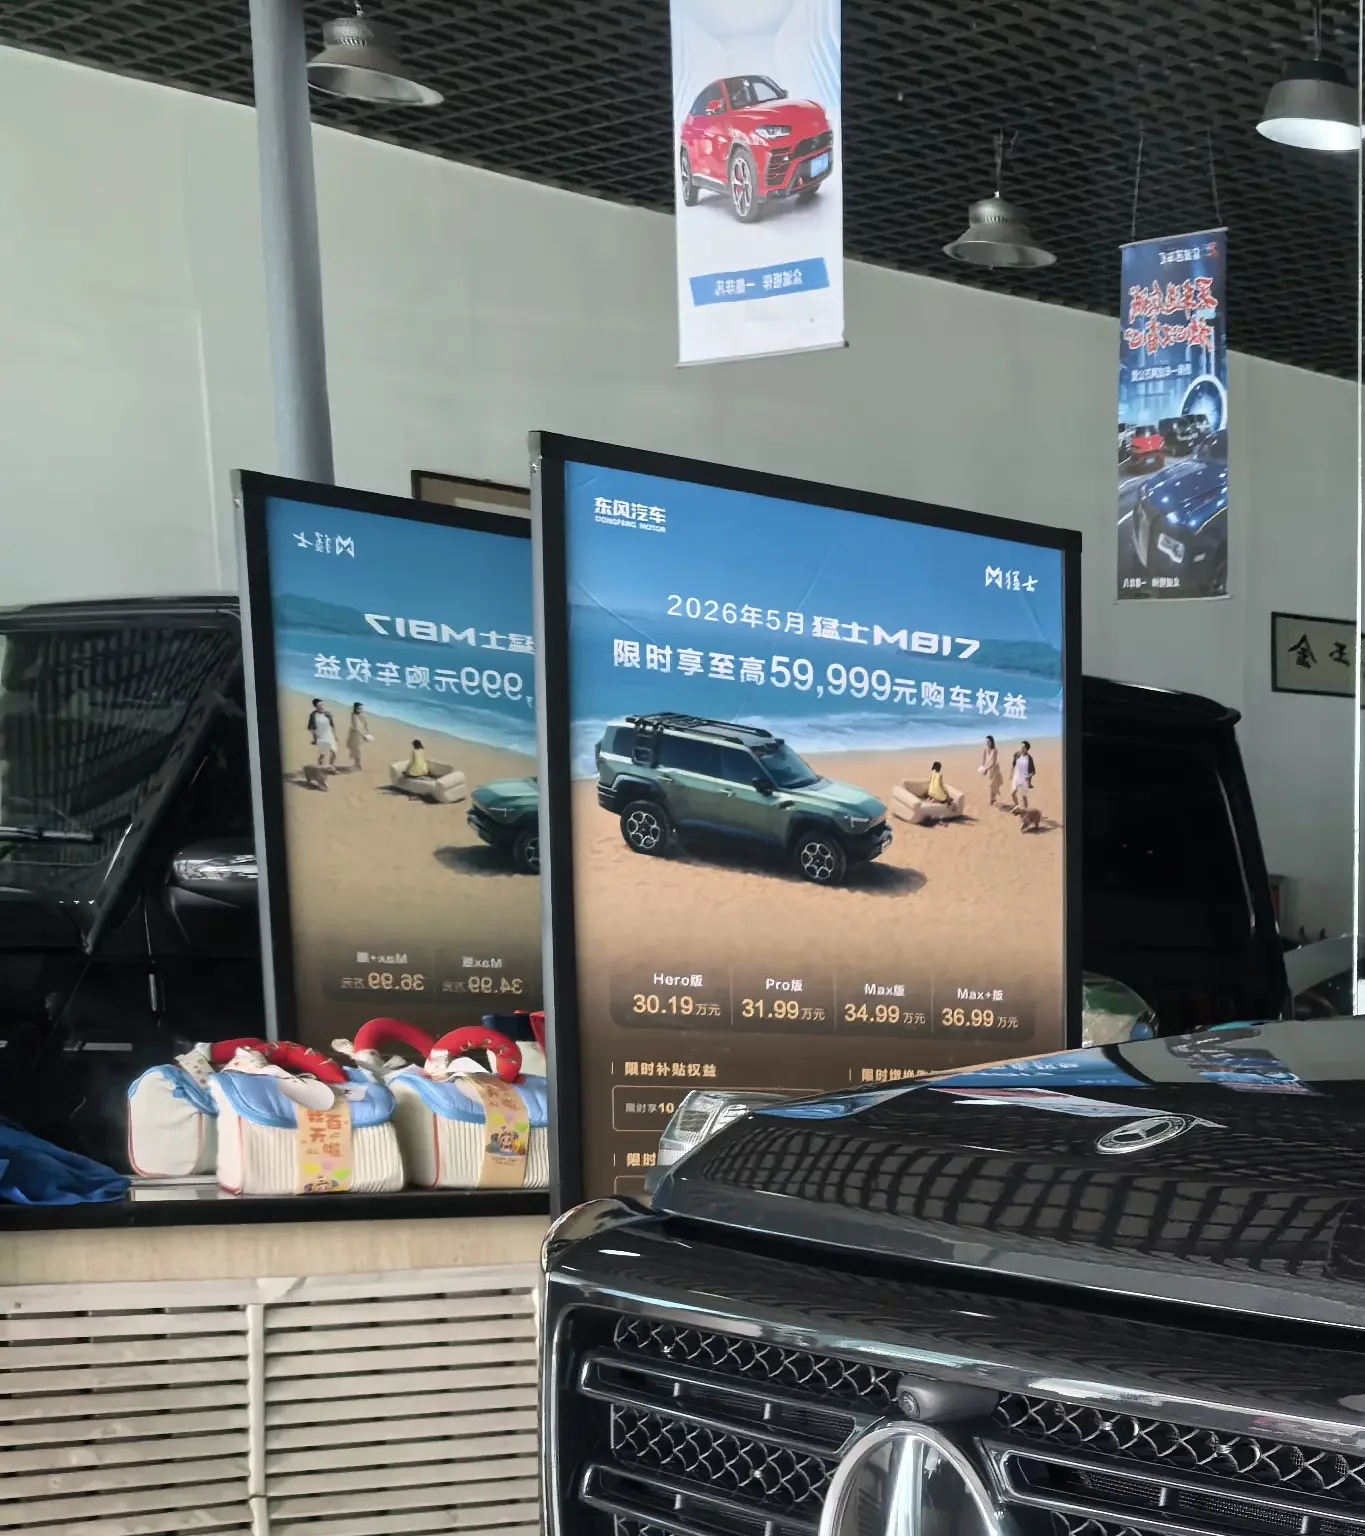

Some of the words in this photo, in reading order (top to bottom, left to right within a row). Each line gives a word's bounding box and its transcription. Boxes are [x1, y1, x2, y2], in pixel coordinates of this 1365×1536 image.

[594, 496, 667, 524] 东风汽车
[666, 593, 804, 636] 2026年5月
[612, 637, 1028, 721] 限时享至高59,999元购车权益
[652, 972, 704, 988] Hero版
[765, 978, 804, 993] Pro版
